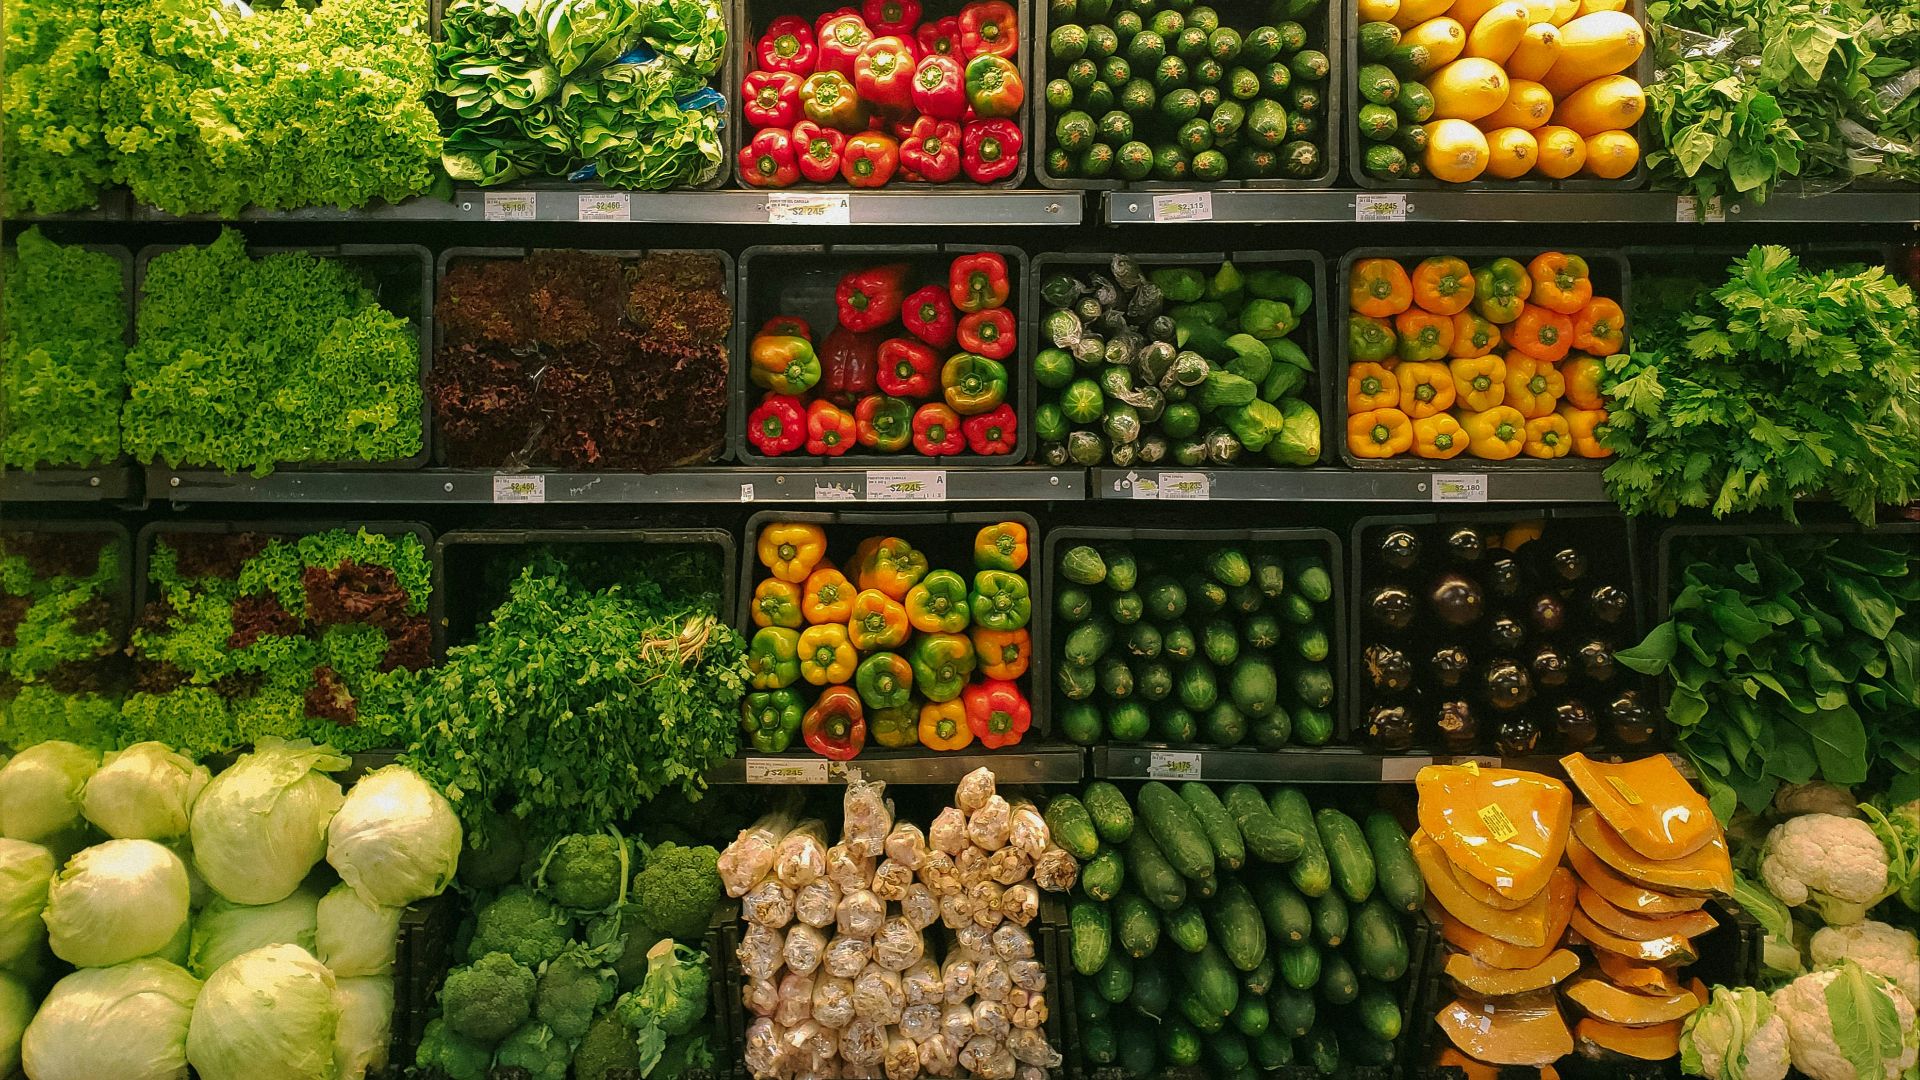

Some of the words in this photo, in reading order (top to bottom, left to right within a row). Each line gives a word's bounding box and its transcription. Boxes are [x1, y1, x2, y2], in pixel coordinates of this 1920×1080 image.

[890, 484, 921, 492] $2,245
[1167, 761, 1191, 769] $1,175
[771, 769, 803, 777] $2,245
